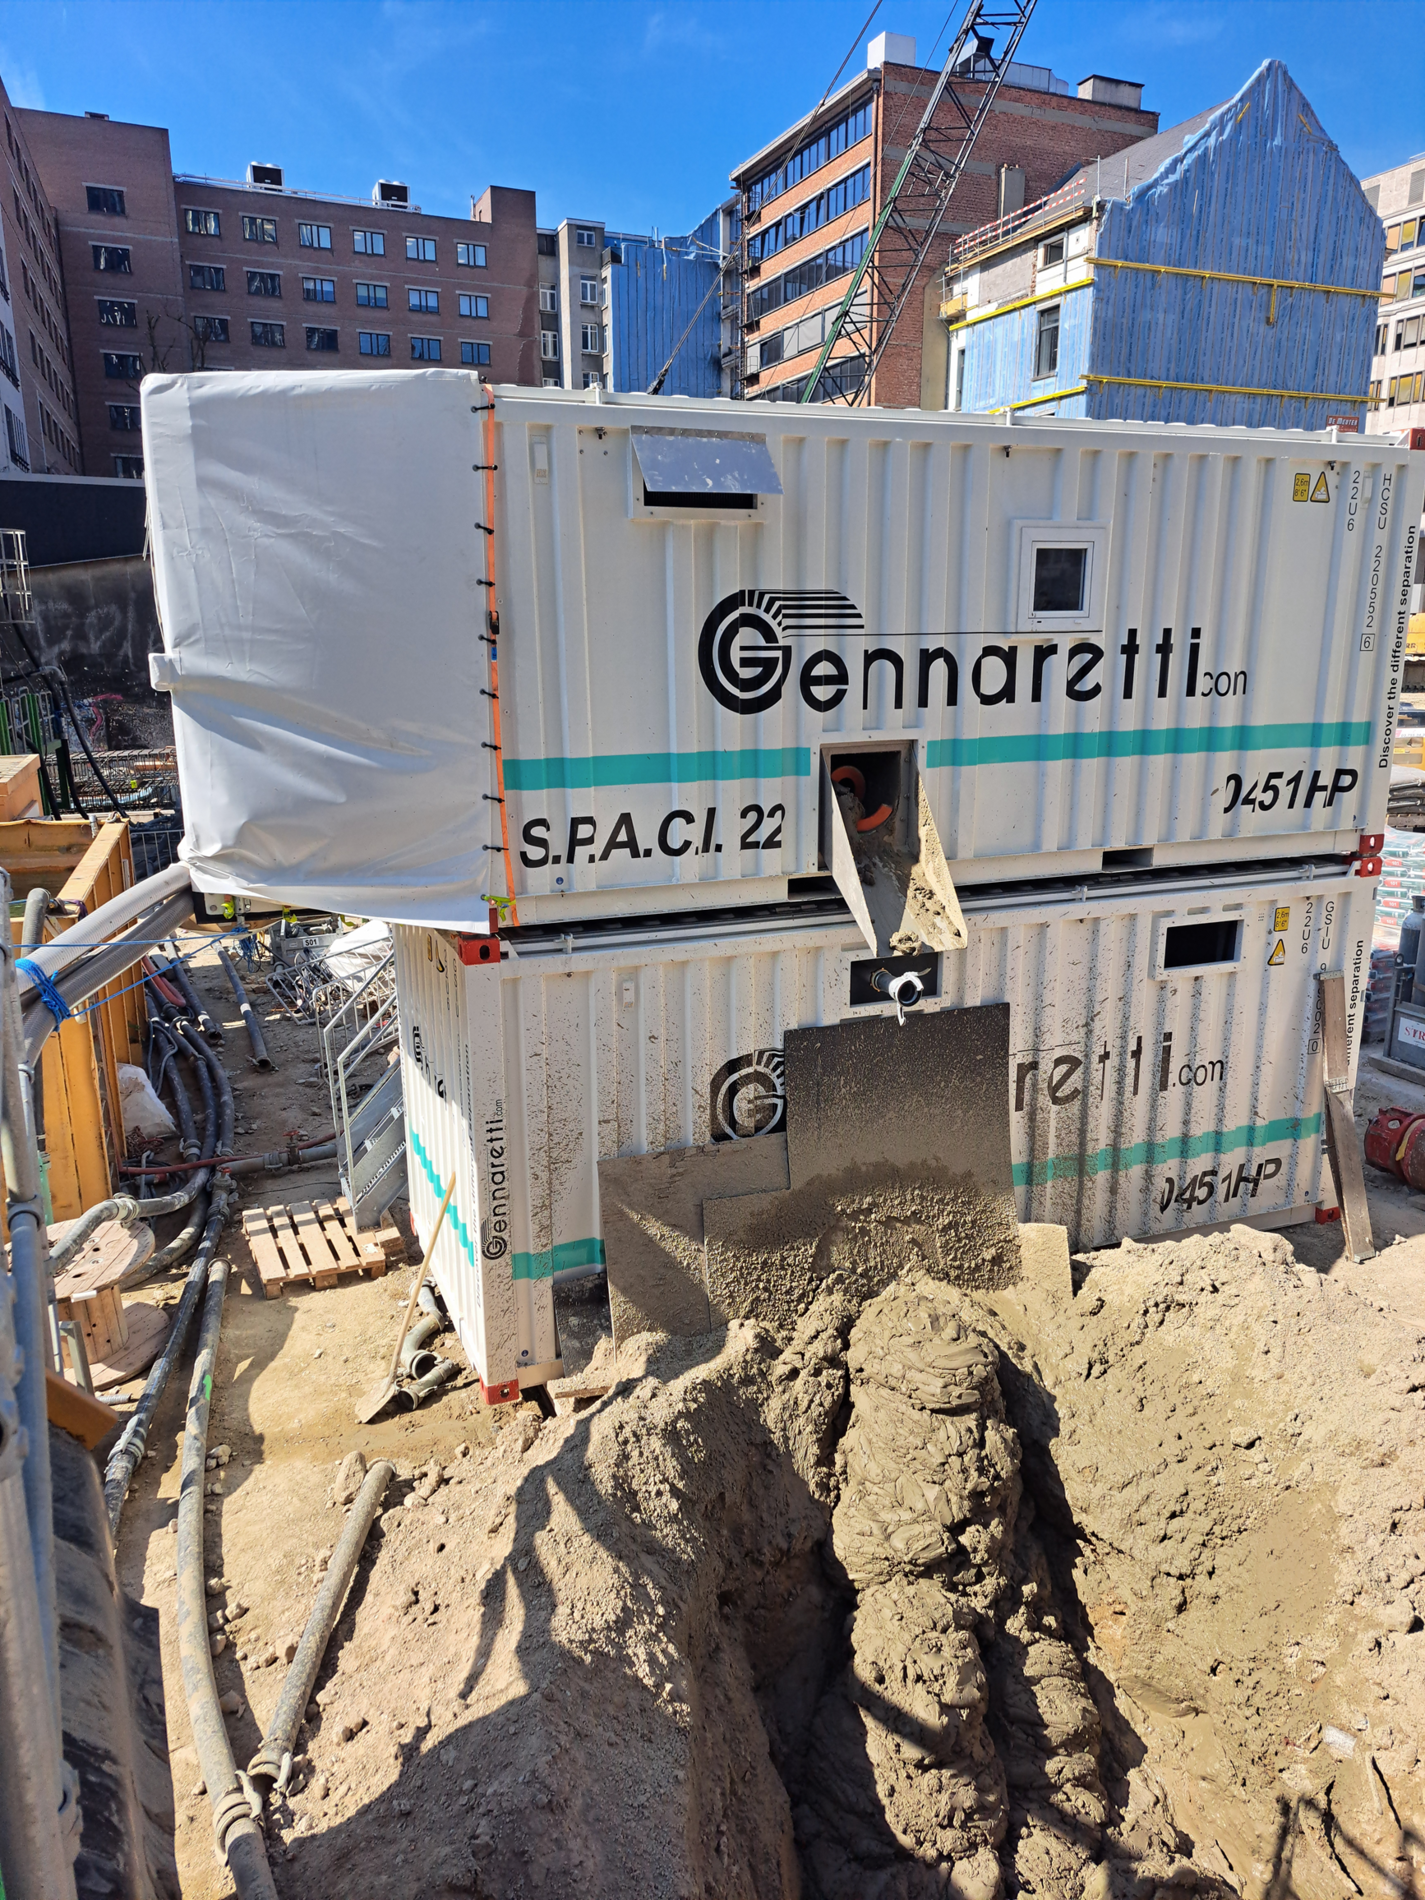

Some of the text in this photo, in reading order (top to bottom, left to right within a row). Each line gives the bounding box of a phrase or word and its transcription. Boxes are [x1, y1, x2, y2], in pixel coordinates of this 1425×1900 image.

[1377, 473, 1392, 529] HCSU
[1366, 545, 1382, 627] 220552
[1379, 525, 1416, 768] Discover the different separation
[740, 803, 785, 850] 22
[1301, 902, 1313, 954] 22U6
[1322, 901, 1335, 950] GSIU
[1350, 940, 1363, 1009] separation
